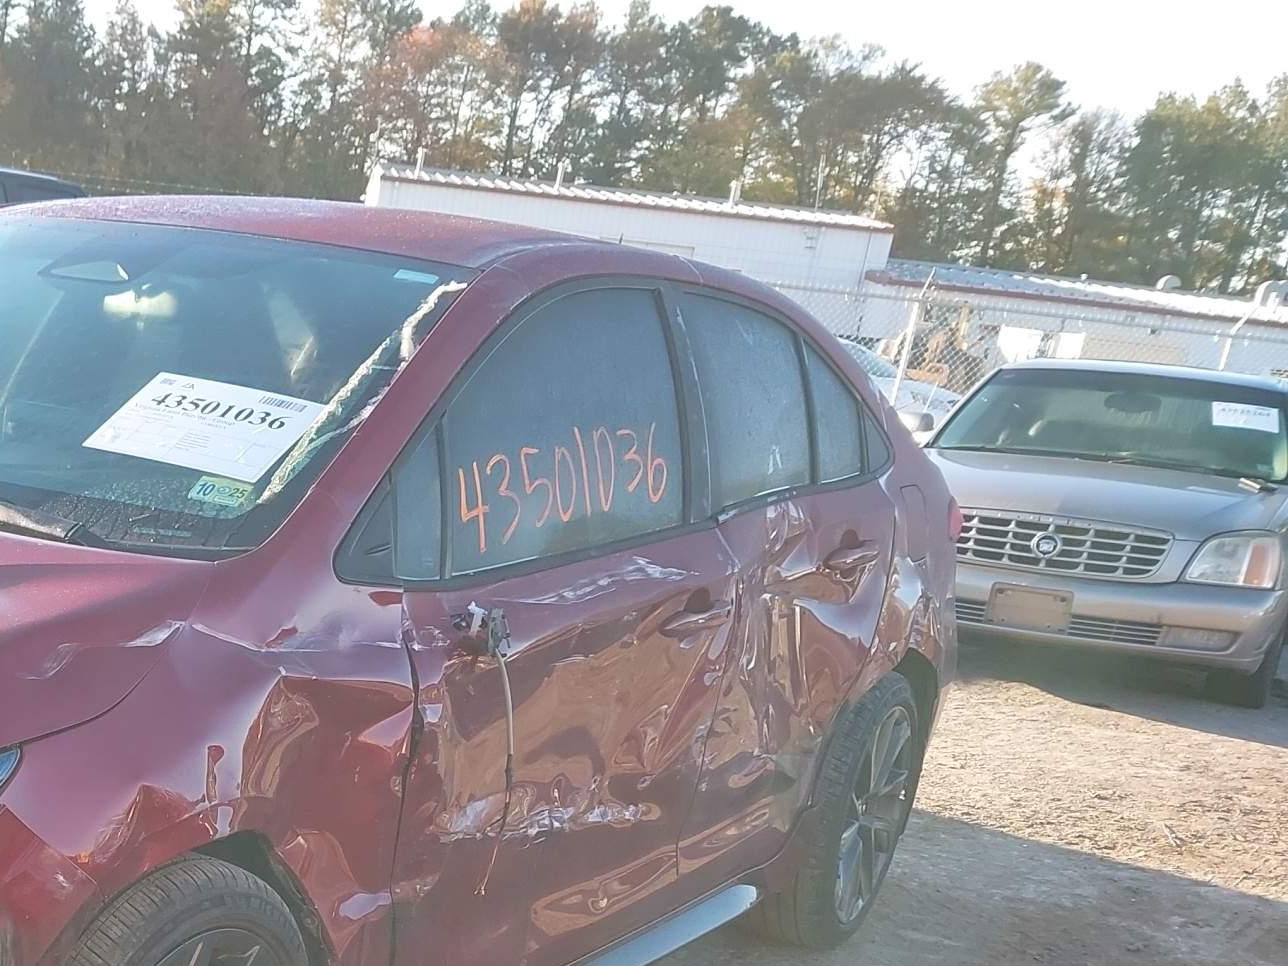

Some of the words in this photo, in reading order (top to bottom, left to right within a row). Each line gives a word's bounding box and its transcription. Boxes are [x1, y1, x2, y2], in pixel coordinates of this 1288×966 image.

[151, 392, 288, 431] 43501036
[196, 482, 217, 497] 10
[228, 487, 249, 499] 25
[458, 422, 668, 554] 43501036
